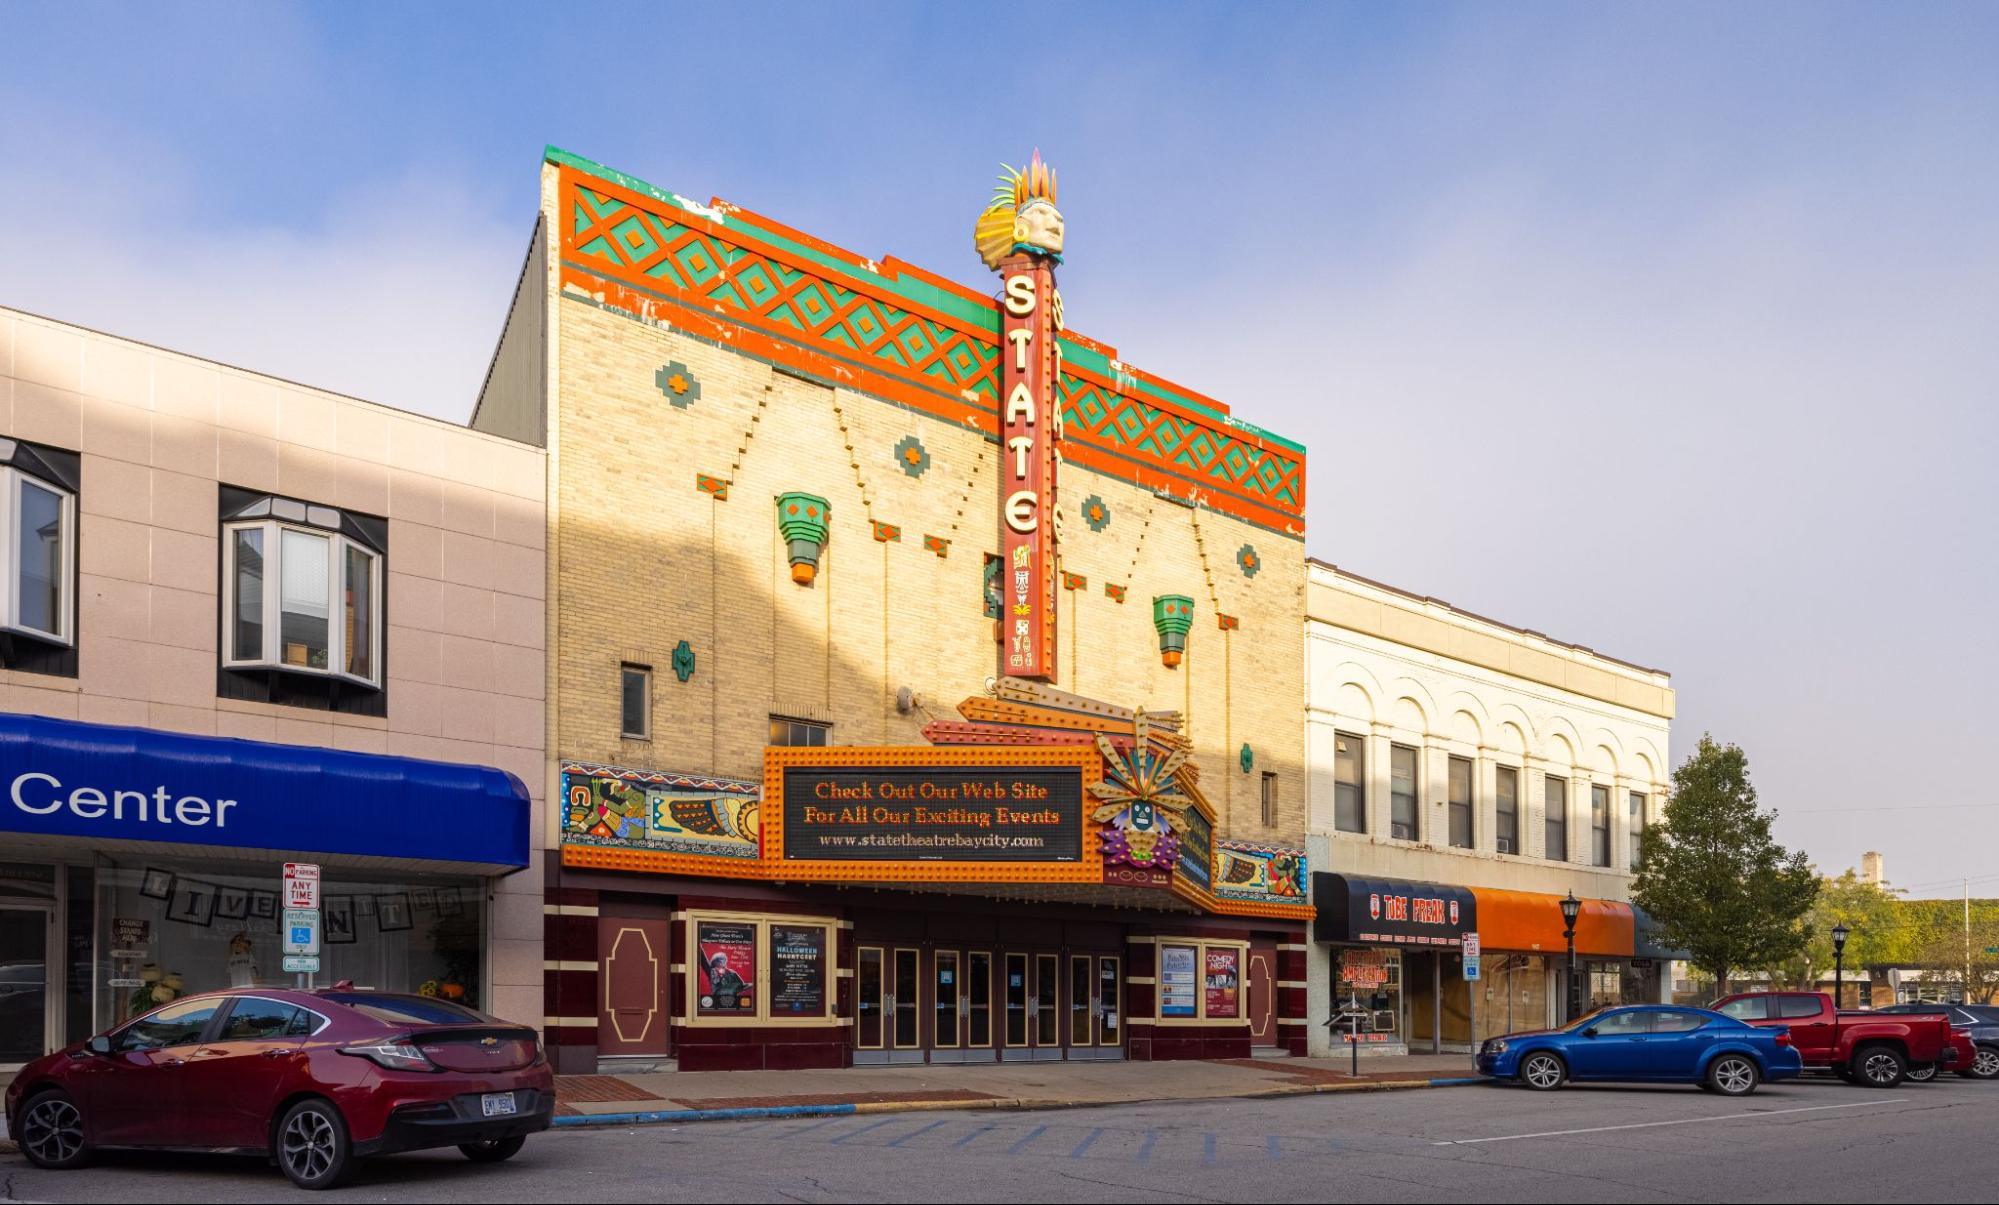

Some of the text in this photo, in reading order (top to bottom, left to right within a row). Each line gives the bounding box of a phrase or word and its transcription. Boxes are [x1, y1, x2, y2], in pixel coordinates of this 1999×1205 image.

[1004, 274, 1037, 535] STATE
[815, 780, 1049, 800] Check Out Our Web Site
[10, 772, 238, 828] Center
[803, 804, 1061, 828] For All Our Exciting Events
[820, 833, 1044, 848] www.statetheatrebaycity.com
[285, 867, 317, 877] NO PARKING
[291, 881, 312, 890] ANY
[290, 890, 312, 900] TIME
[1383, 894, 1408, 921] TUBE
[1413, 898, 1446, 925] FREAK
[777, 946, 818, 954] HALLOWEEN
[1206, 954, 1235, 962] COMEDY
